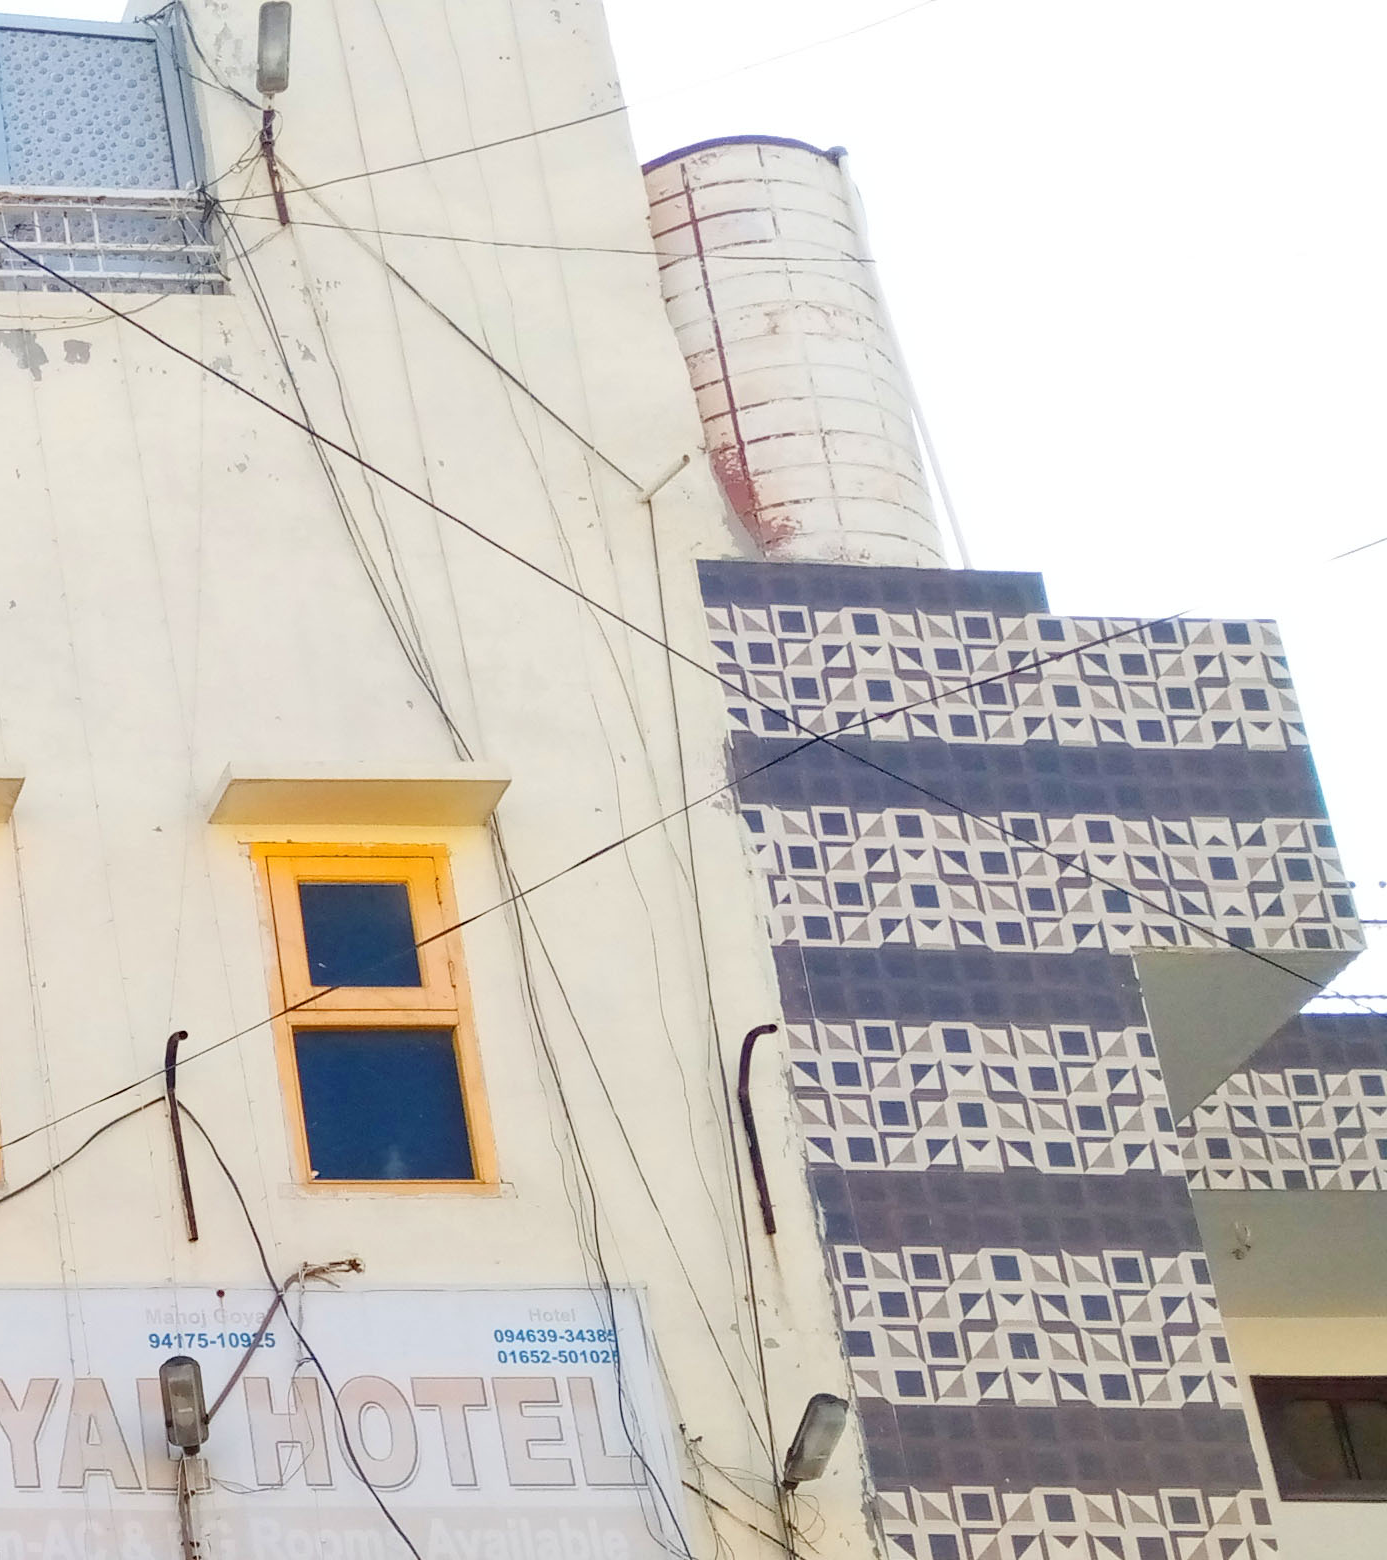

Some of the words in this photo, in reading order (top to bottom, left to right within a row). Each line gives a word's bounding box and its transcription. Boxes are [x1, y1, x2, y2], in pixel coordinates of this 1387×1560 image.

[214, 1308, 270, 1326] Goya
[529, 1308, 577, 1323] Hotel
[242, 1374, 651, 1492] HOTEL
